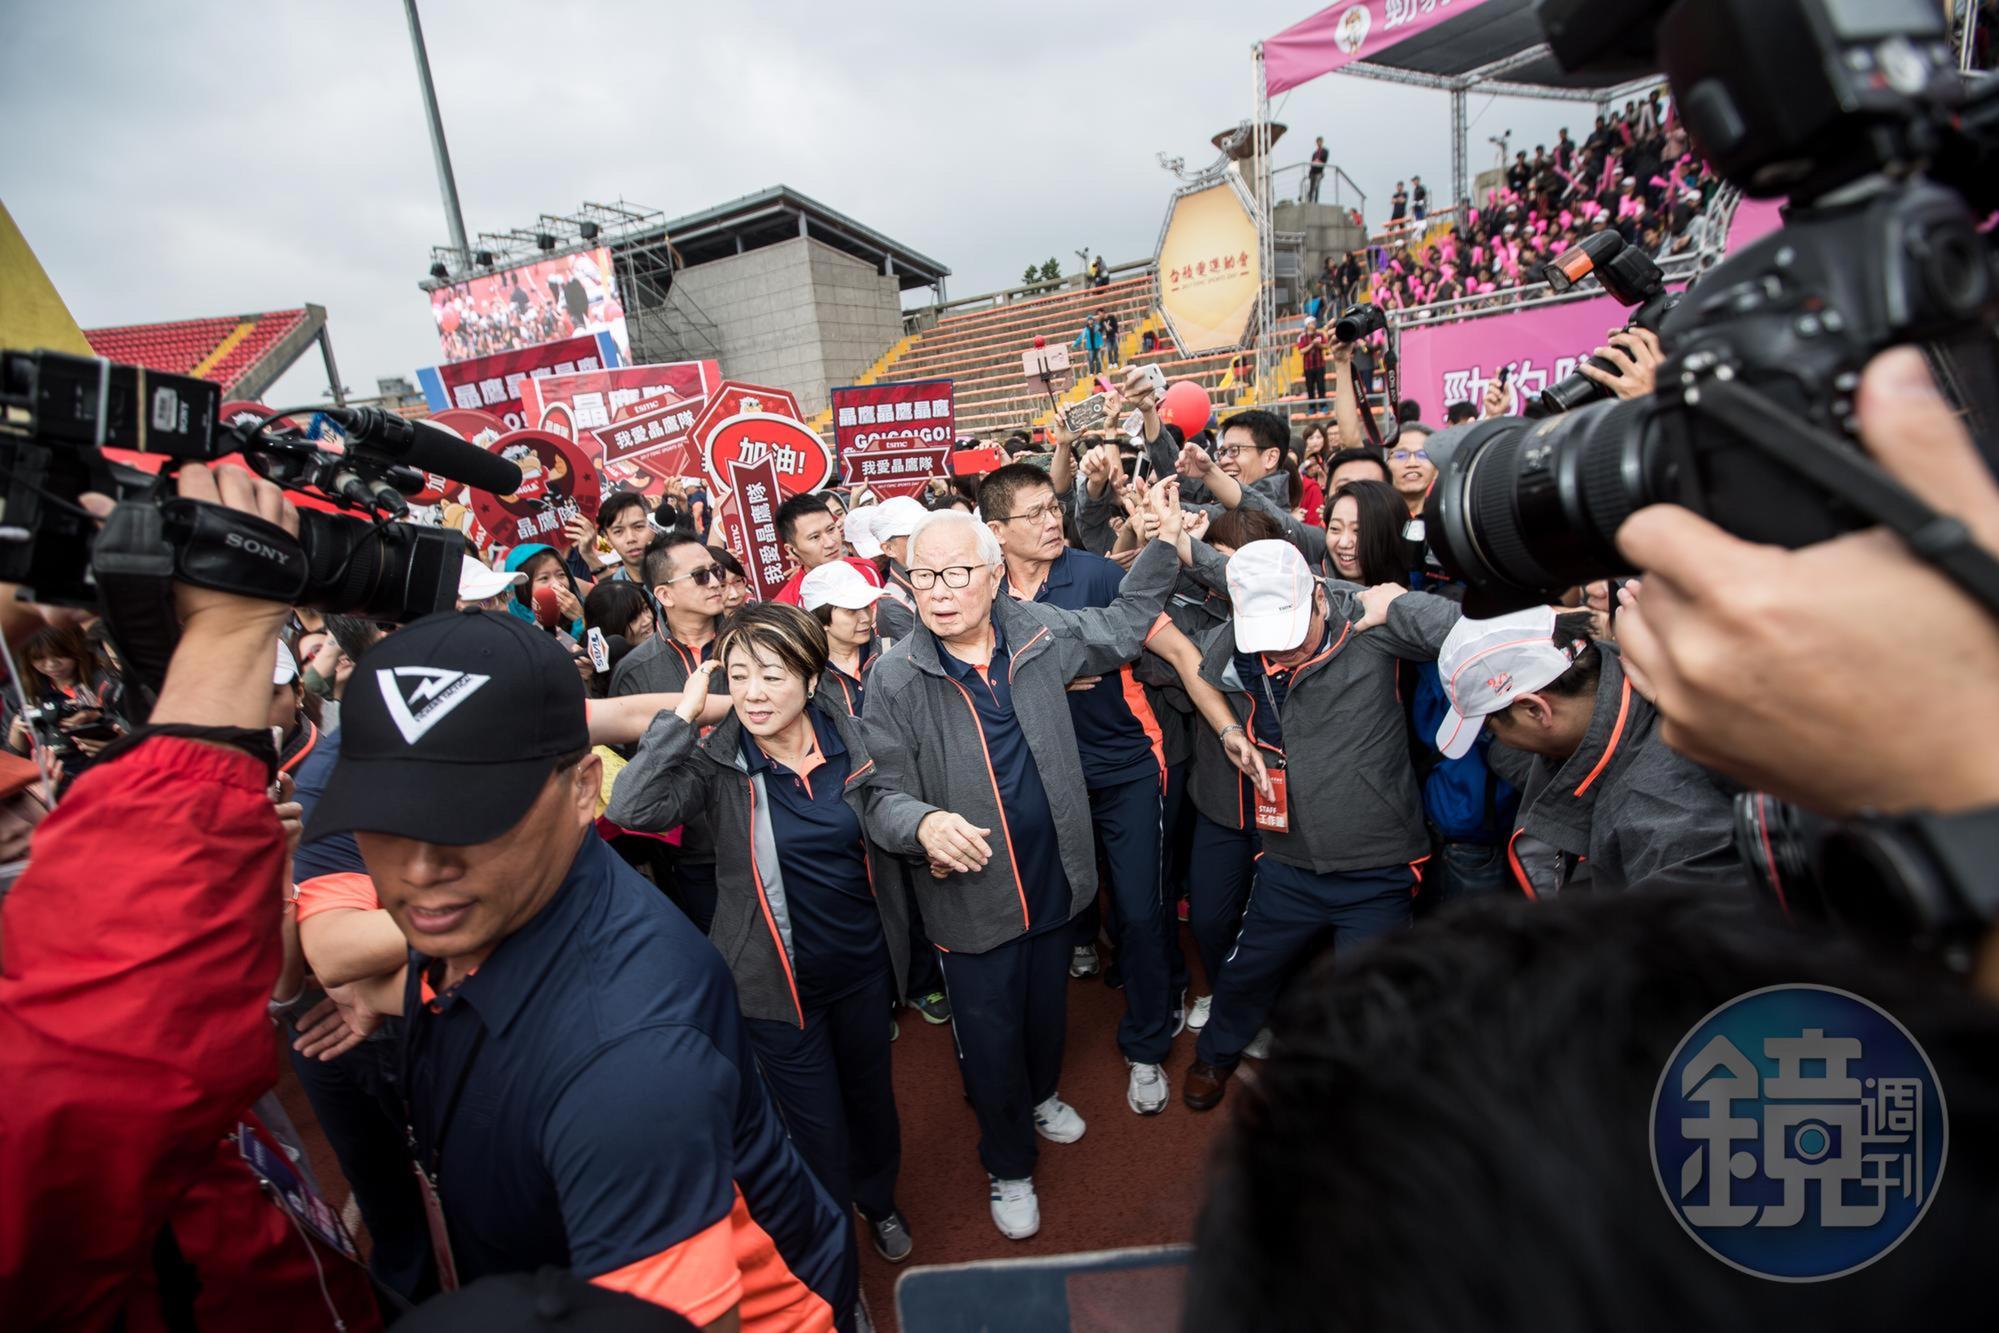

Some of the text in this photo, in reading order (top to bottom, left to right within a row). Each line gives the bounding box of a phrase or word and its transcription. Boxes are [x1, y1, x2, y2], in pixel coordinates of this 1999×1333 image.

[1170, 251, 1248, 284] 台積電運動會
[634, 400, 660, 415] tsmc
[838, 399, 950, 428] 晶鷹晶鷹晶鷹
[613, 409, 696, 451] 我愛晶鷹隊
[738, 436, 806, 476] 加油!
[861, 456, 934, 476] 我愛晶鷹隊
[516, 497, 580, 541] 晶鷹隊
[744, 482, 785, 585] 我愛晶鷹隊
[225, 532, 290, 566] SONY
[730, 524, 744, 554] tsmc
[1258, 805, 1277, 814] STAFF
